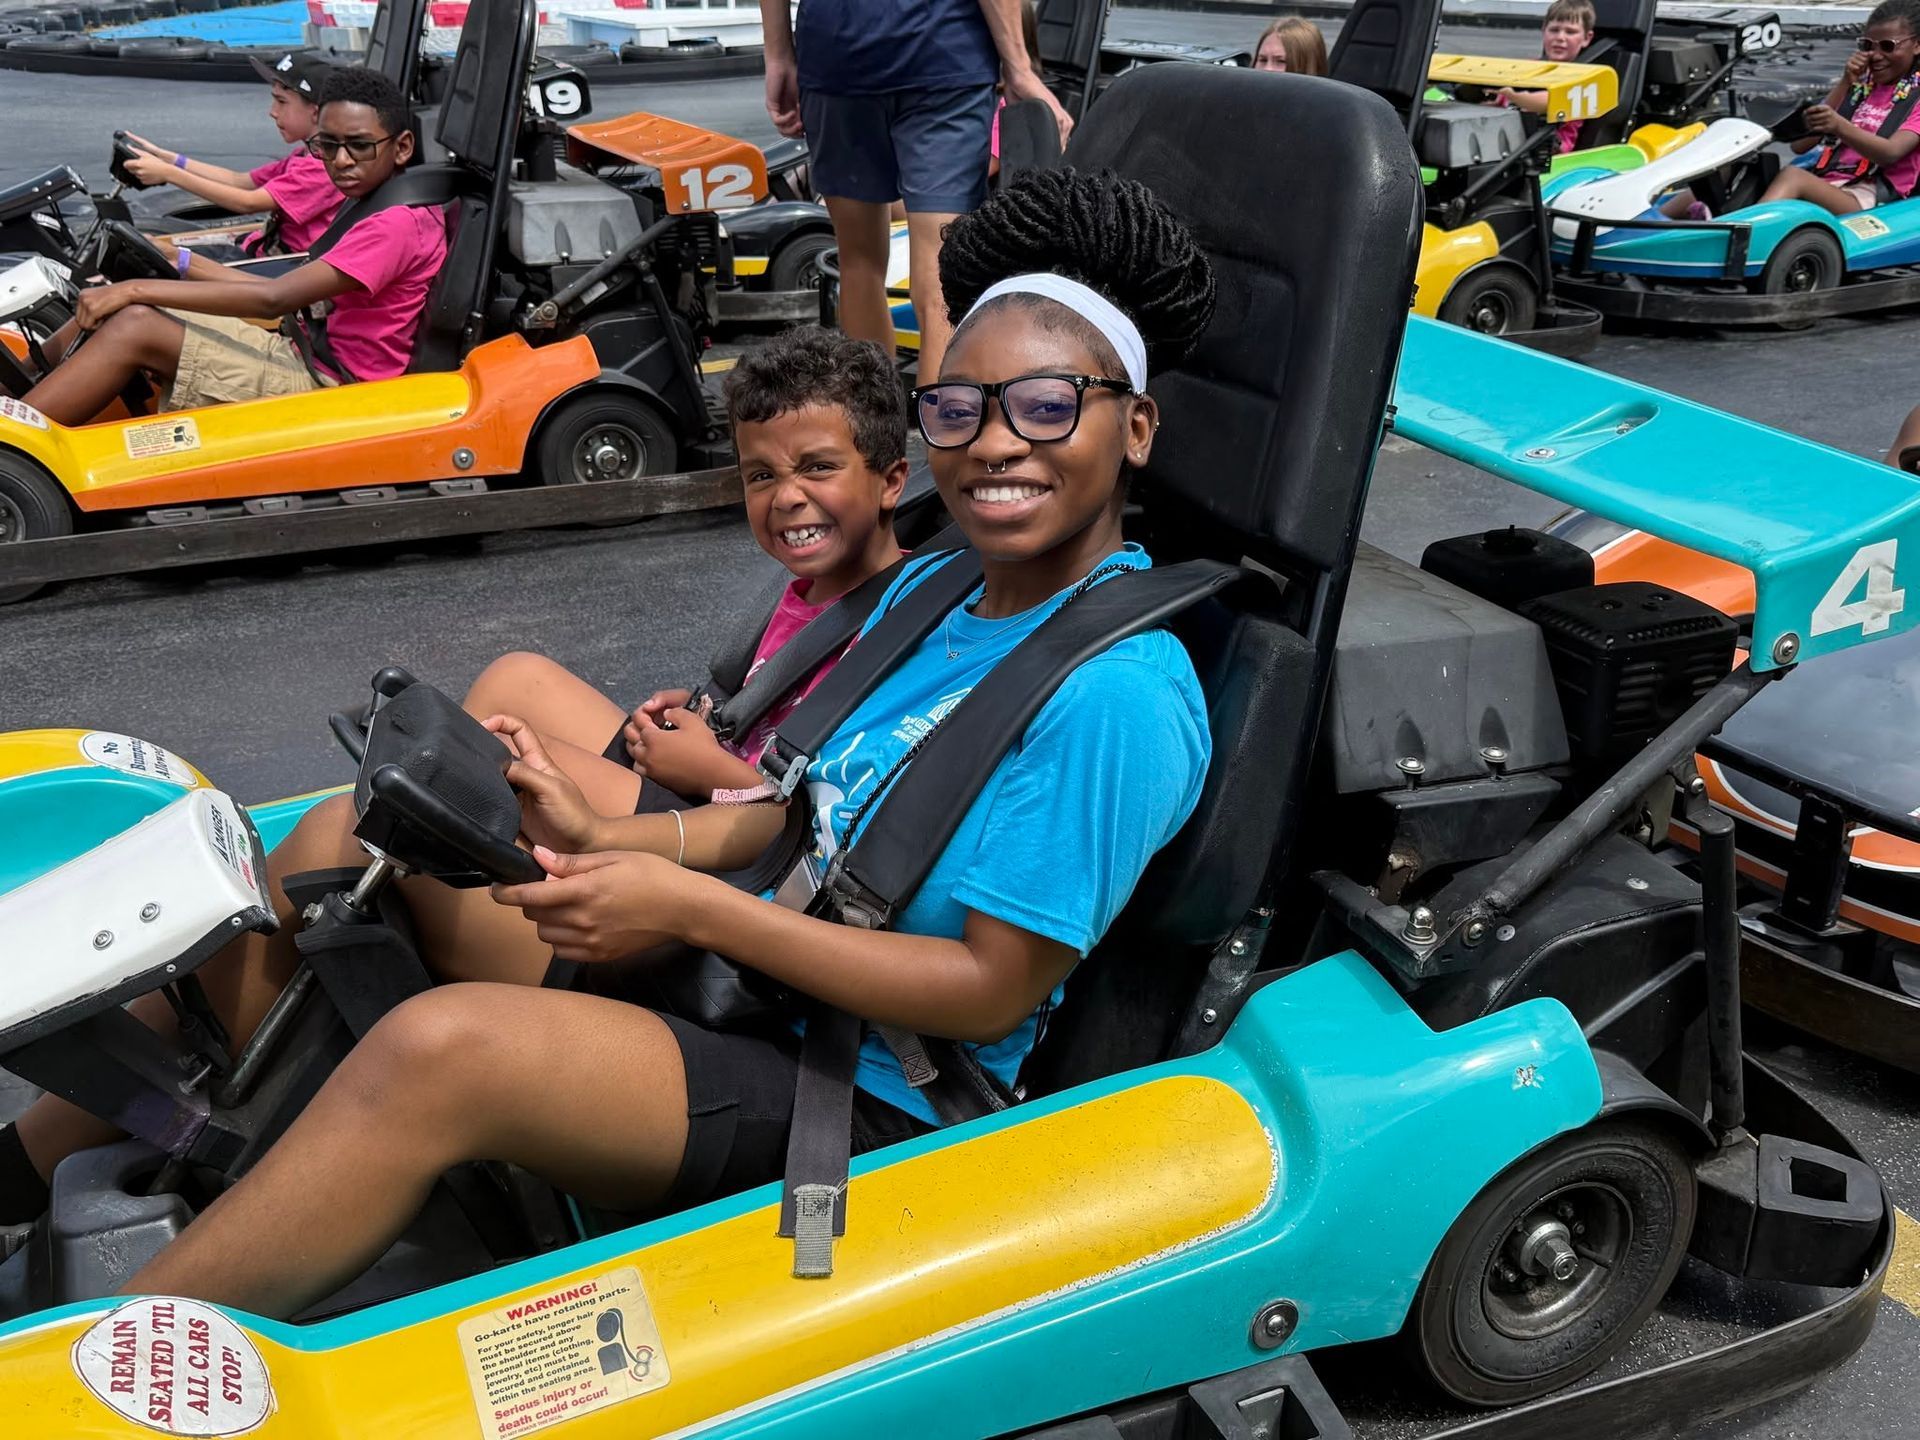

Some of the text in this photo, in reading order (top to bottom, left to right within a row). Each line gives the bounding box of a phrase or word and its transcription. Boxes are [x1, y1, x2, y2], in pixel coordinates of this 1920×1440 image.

[1741, 22, 1782, 51] 20
[529, 80, 582, 117] 19
[1566, 82, 1598, 118] 11
[680, 164, 755, 211] 12
[1810, 538, 1905, 637] 4
[103, 741, 119, 755] No
[211, 804, 228, 852] DANGER
[474, 1287, 631, 1343] Go-karts have rotating parts.
[506, 1282, 598, 1321] WARNING!
[477, 1311, 594, 1355] For your safety, longer hair
[480, 1324, 582, 1363] must be secured above
[110, 1320, 137, 1394] REMAIN
[187, 1318, 210, 1416] ALL CARS
[482, 1336, 574, 1371] the shoulder and any
[484, 1339, 594, 1380] personal items (clothing,
[486, 1351, 580, 1390] jewelry, etc) must be
[148, 1339, 174, 1423] SEATED
[222, 1345, 242, 1405] STOP!
[489, 1357, 590, 1397] secured and contained
[491, 1366, 597, 1406] within the seating area.
[494, 1380, 592, 1420] Serious injury or
[498, 1386, 609, 1433] death could occur!
